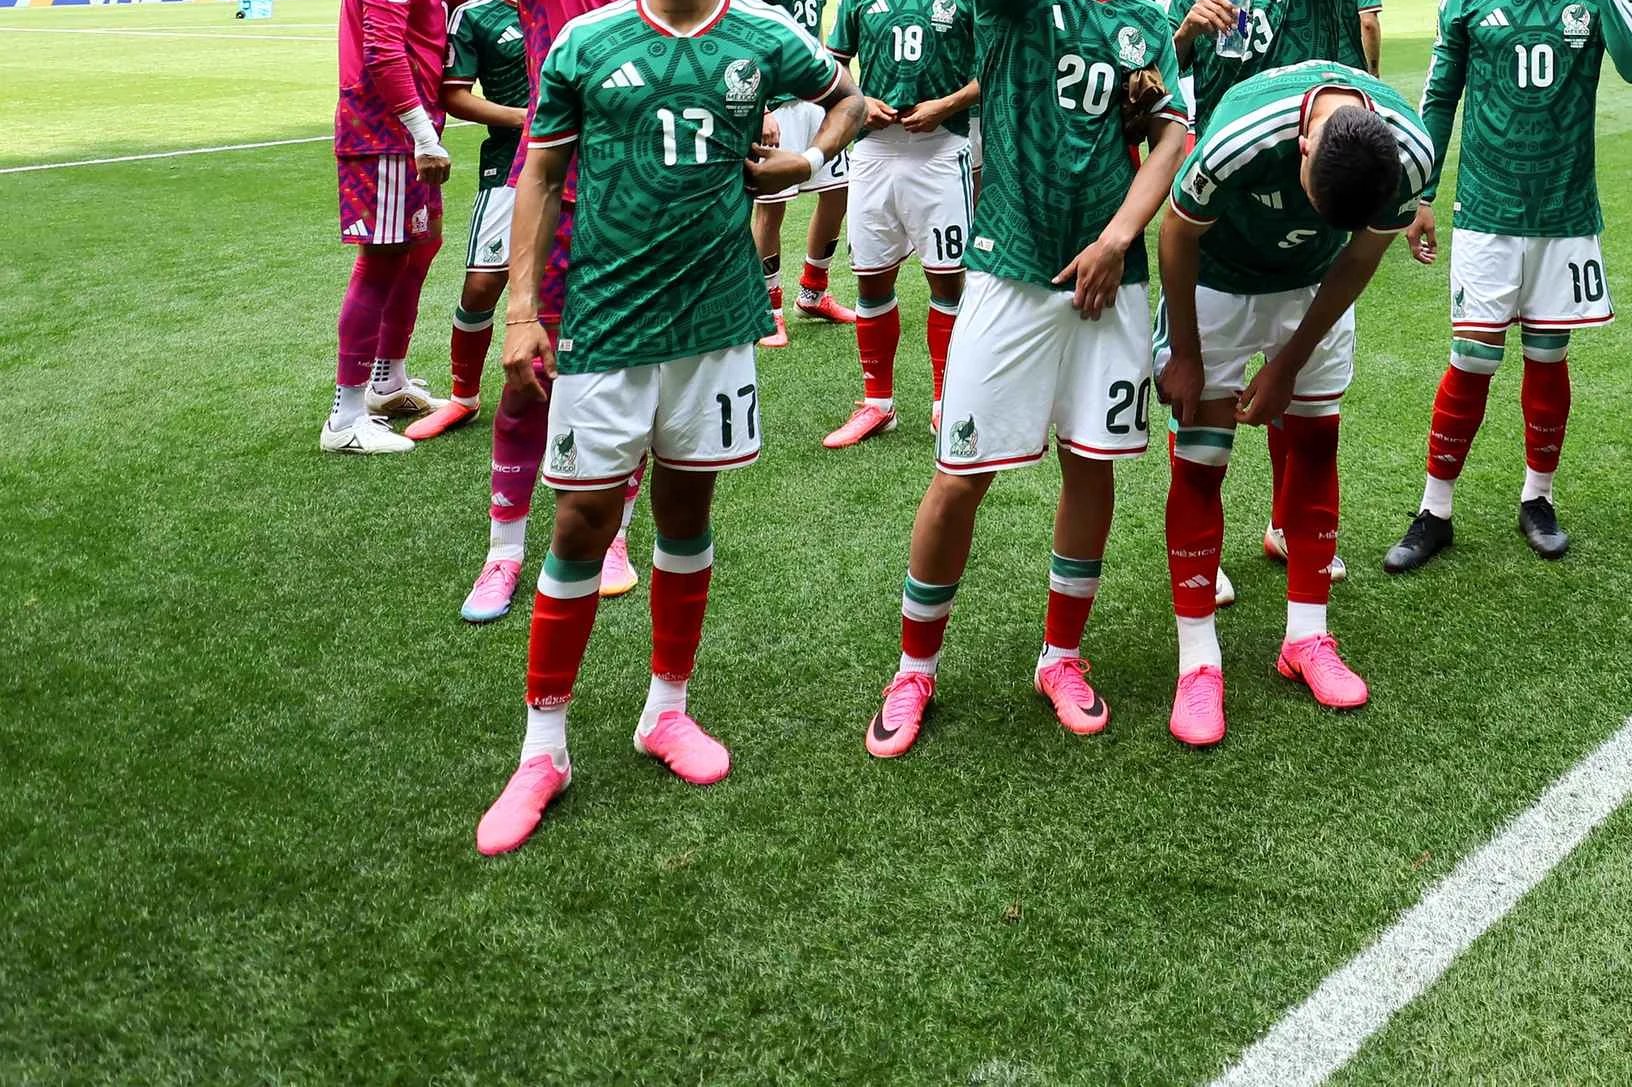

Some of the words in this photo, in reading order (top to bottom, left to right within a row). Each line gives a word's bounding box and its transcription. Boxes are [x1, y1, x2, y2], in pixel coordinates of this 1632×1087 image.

[892, 24, 923, 62] 18
[1514, 43, 1554, 89] 10
[1056, 53, 1116, 115] 20
[656, 107, 715, 166] 17
[933, 225, 963, 261] 18
[1567, 259, 1605, 304] 10
[716, 383, 756, 448] 17
[1106, 380, 1151, 434] 20
